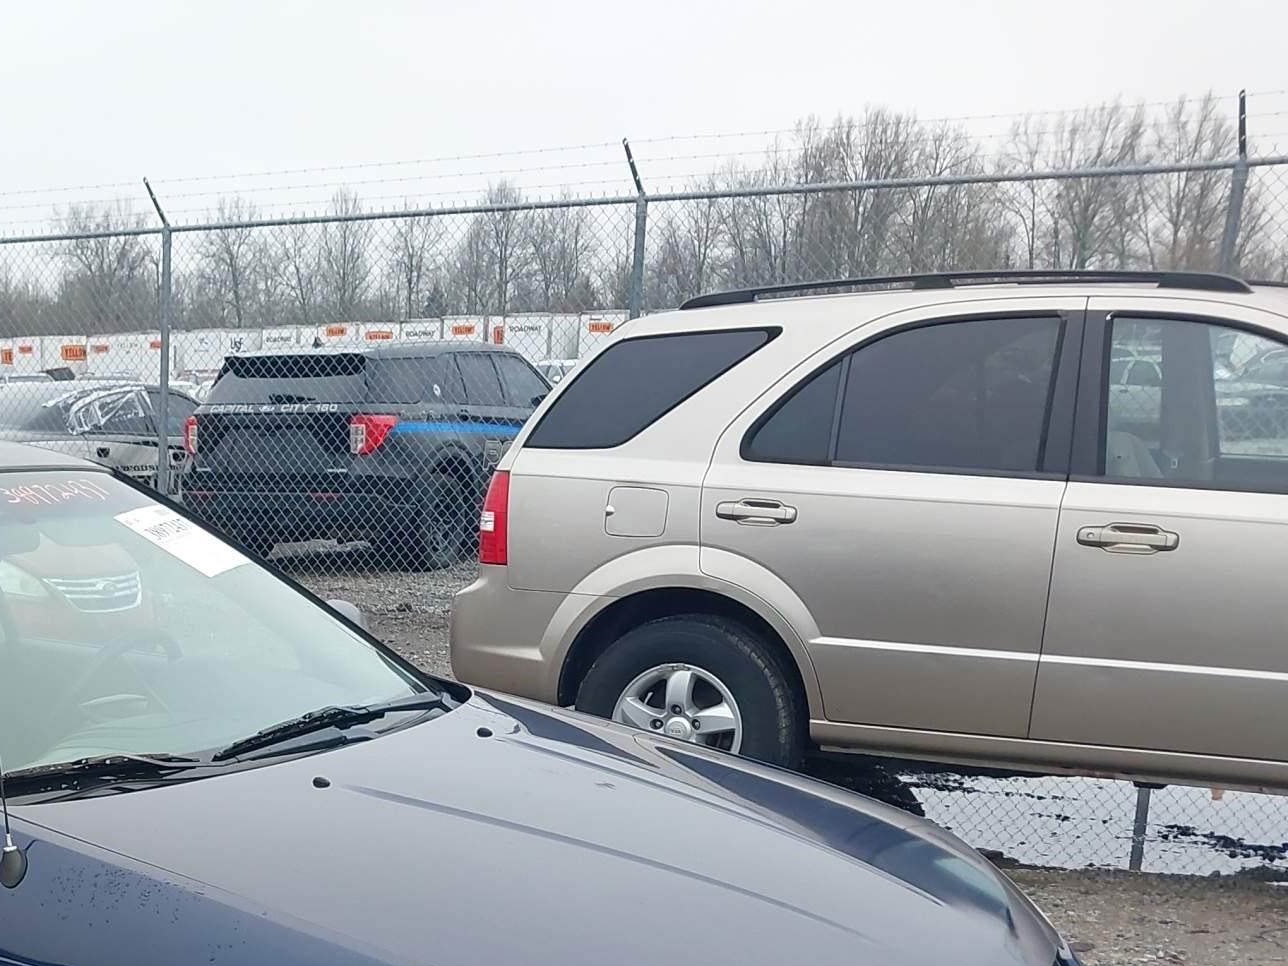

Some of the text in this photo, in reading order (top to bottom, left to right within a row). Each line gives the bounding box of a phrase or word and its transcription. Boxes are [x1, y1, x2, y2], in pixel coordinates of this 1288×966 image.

[509, 324, 542, 333] ROADWAY
[406, 329, 436, 338] ROADWAY
[210, 405, 255, 413] CAPITAL
[280, 404, 310, 412] CITY
